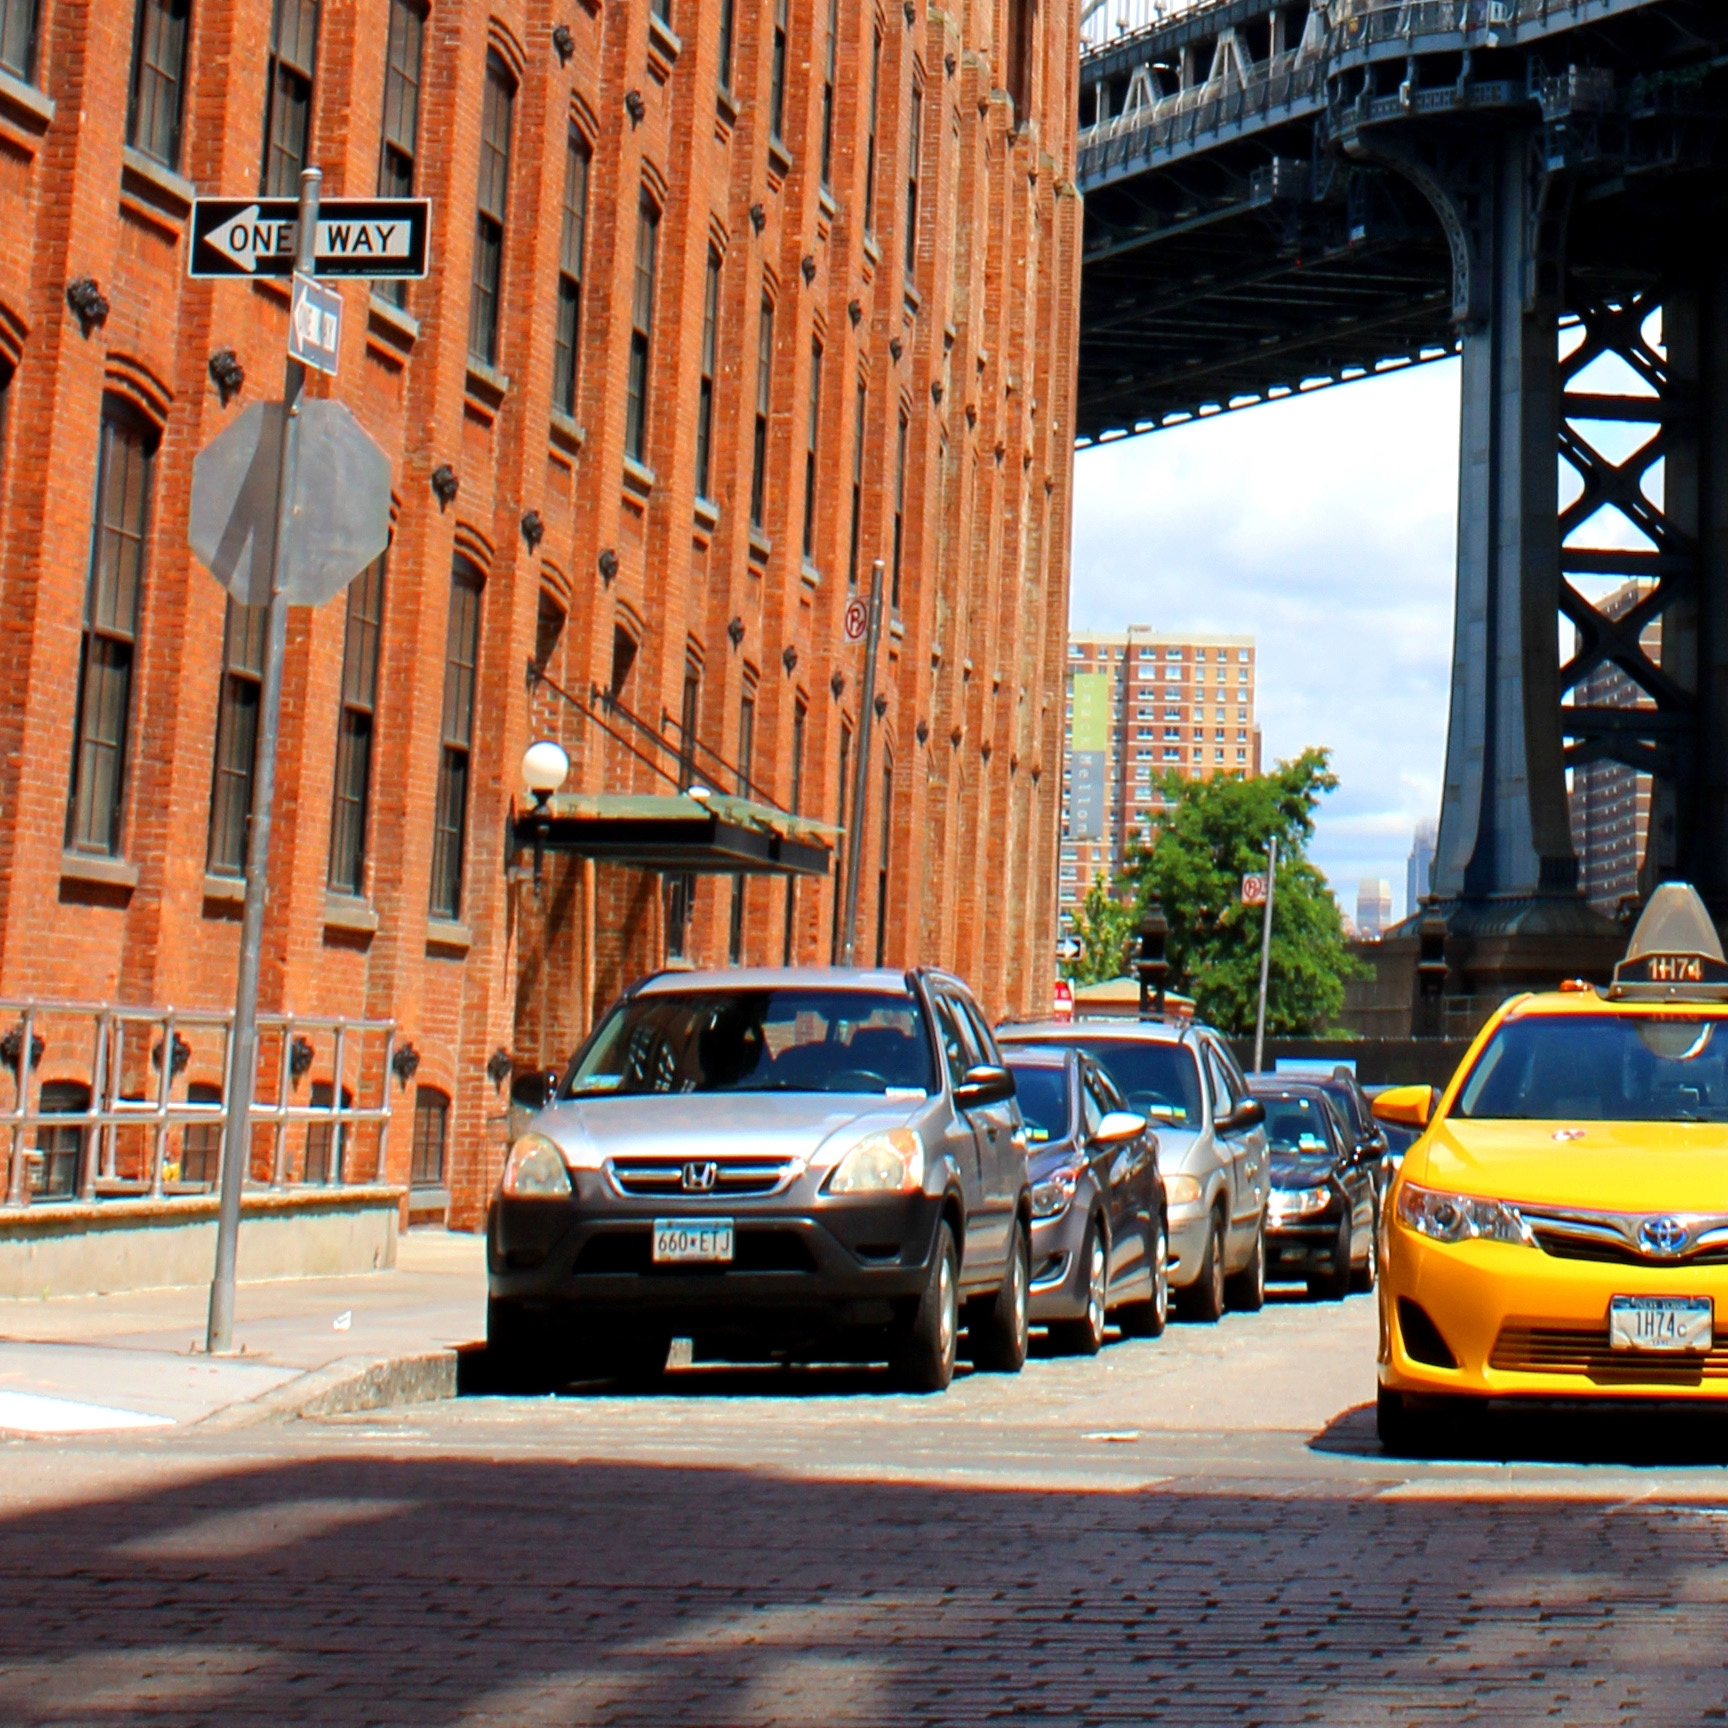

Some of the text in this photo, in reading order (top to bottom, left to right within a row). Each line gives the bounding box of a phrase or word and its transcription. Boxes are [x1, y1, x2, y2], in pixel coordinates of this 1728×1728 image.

[229, 223, 397, 253] ONE WAY
[1076, 754, 1093, 833] Mellon
[1648, 957, 1703, 981] 1H74
[657, 1230, 731, 1252] 660 ETJ
